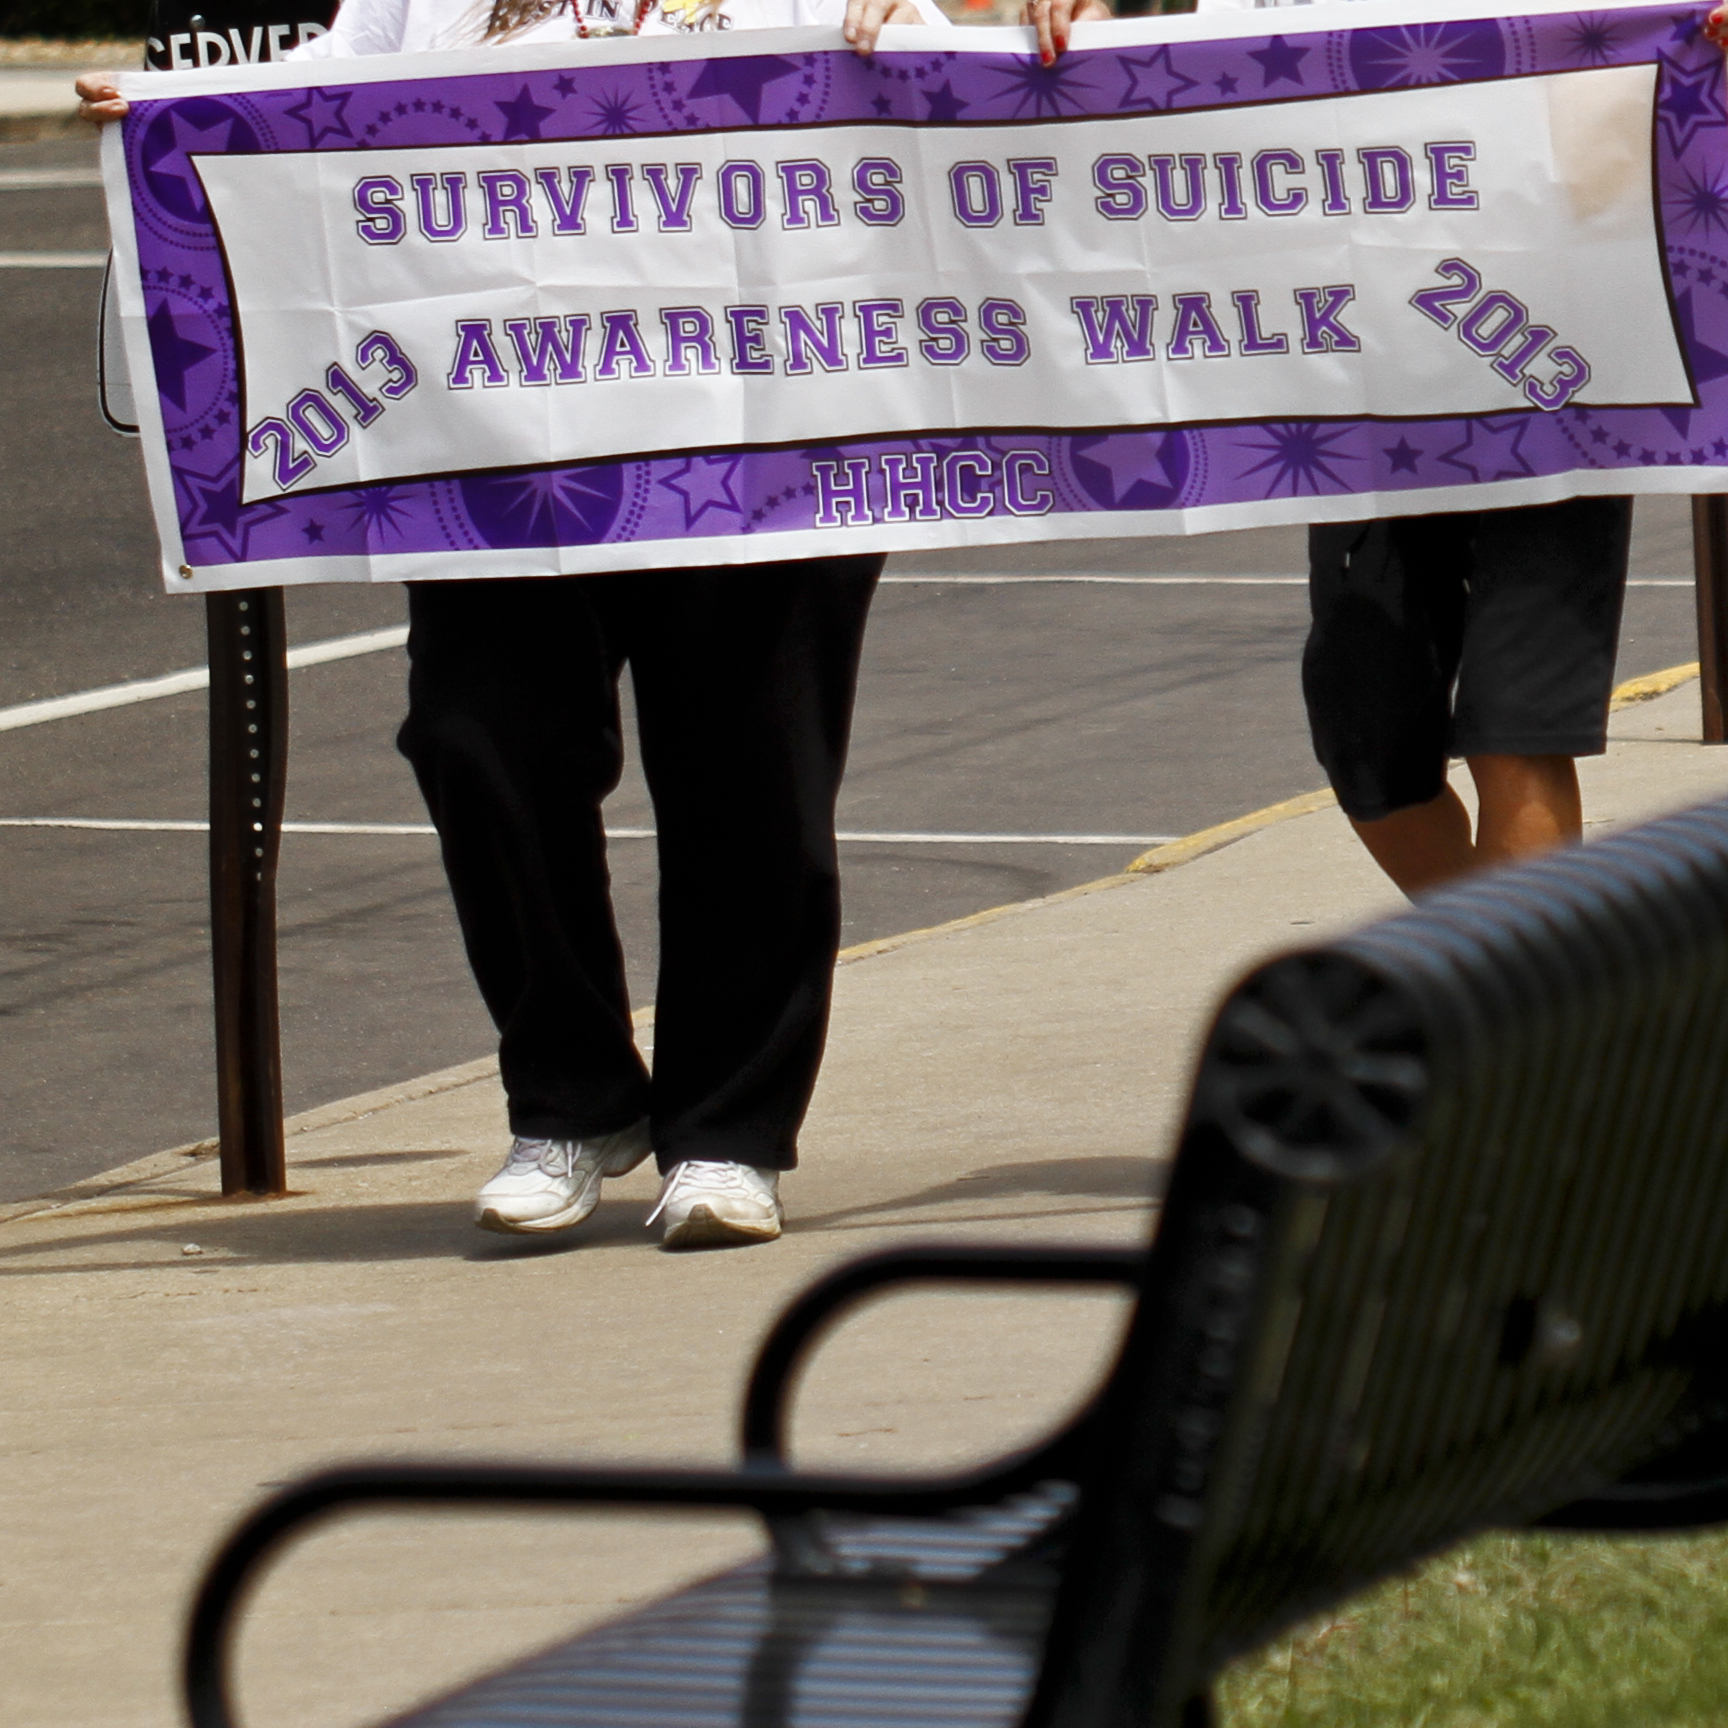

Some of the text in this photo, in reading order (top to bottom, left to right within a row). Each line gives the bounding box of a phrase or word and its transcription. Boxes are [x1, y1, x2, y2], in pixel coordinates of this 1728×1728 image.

[352, 140, 1480, 246] SURVIVORS OF SUICIDE
[447, 283, 1361, 390] AWARENESS WALK
[1408, 257, 1592, 412] 2013
[247, 329, 419, 491] 2013
[811, 448, 1056, 529] HHCC
